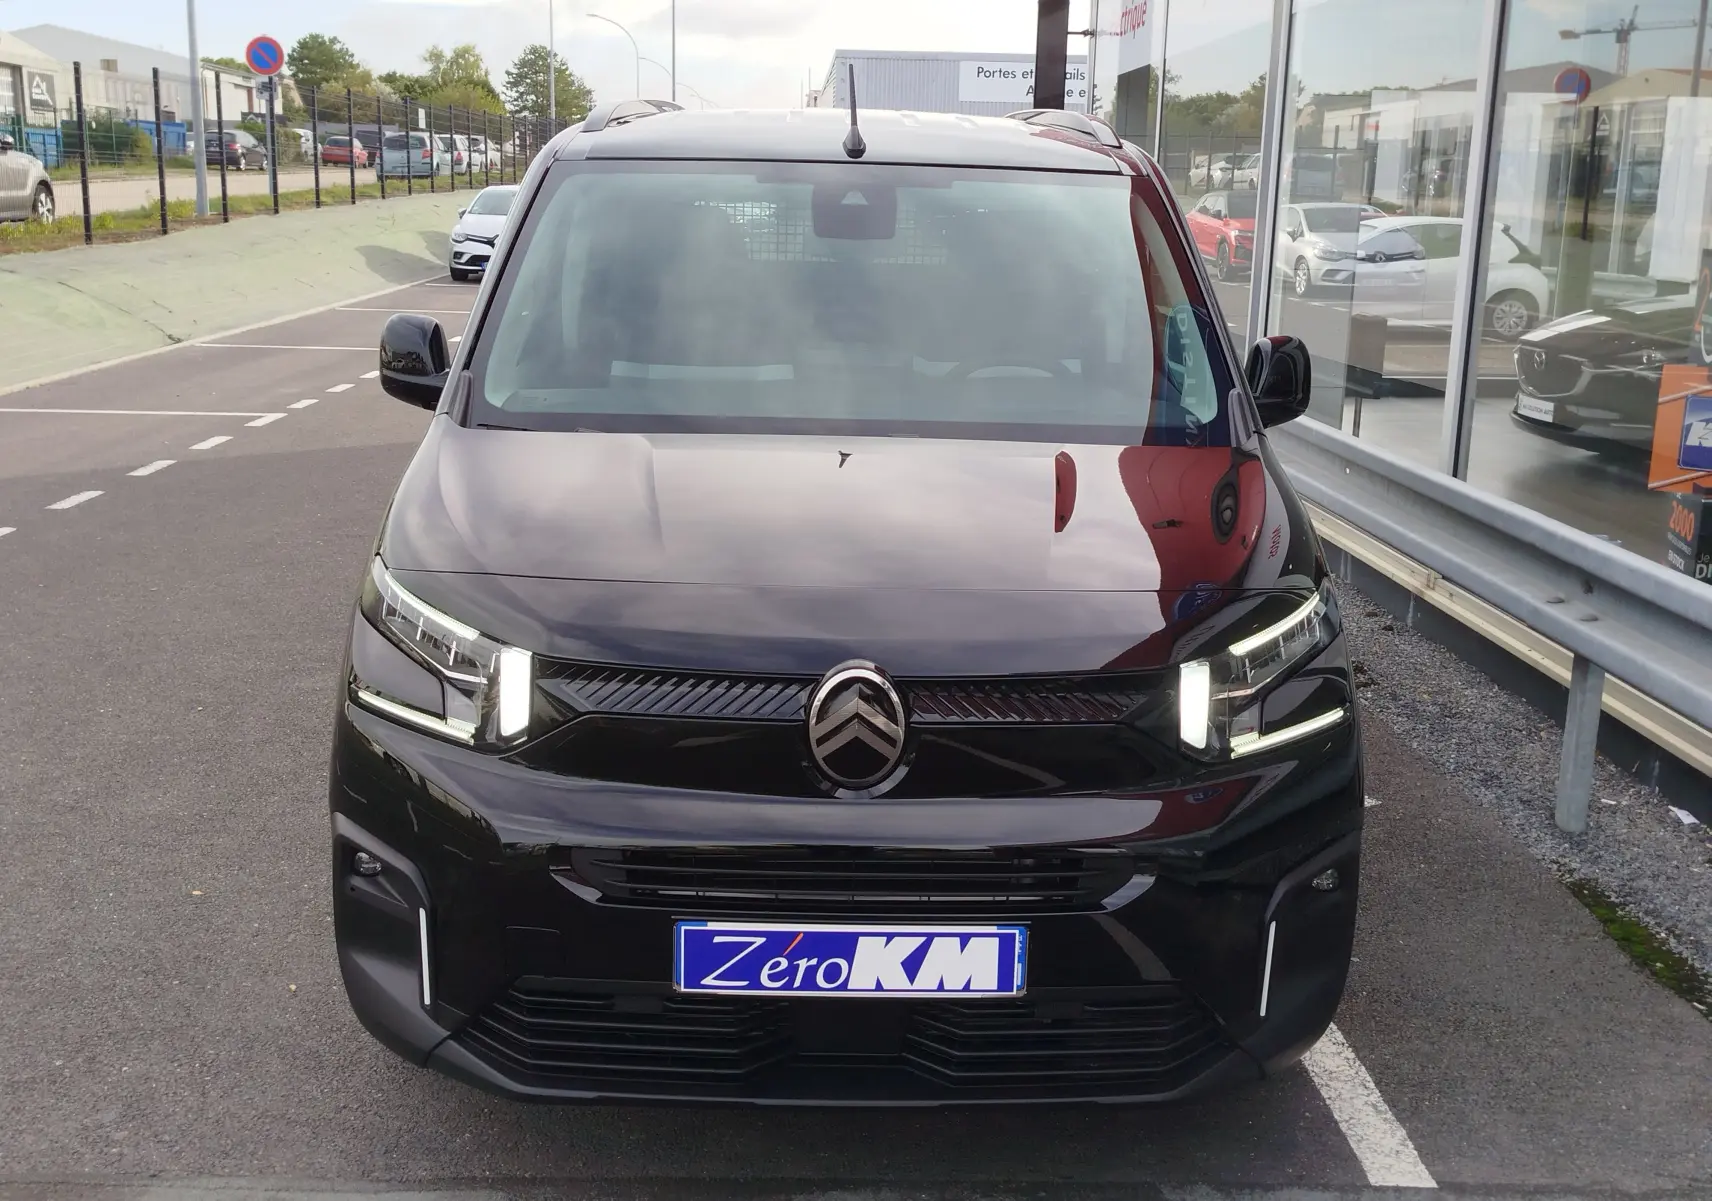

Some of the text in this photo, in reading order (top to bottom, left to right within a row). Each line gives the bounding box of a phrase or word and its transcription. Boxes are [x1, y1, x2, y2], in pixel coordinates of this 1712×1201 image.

[976, 66, 1017, 79] Portes
[1021, 68, 1034, 79] et
[1669, 500, 1695, 542] 2000
